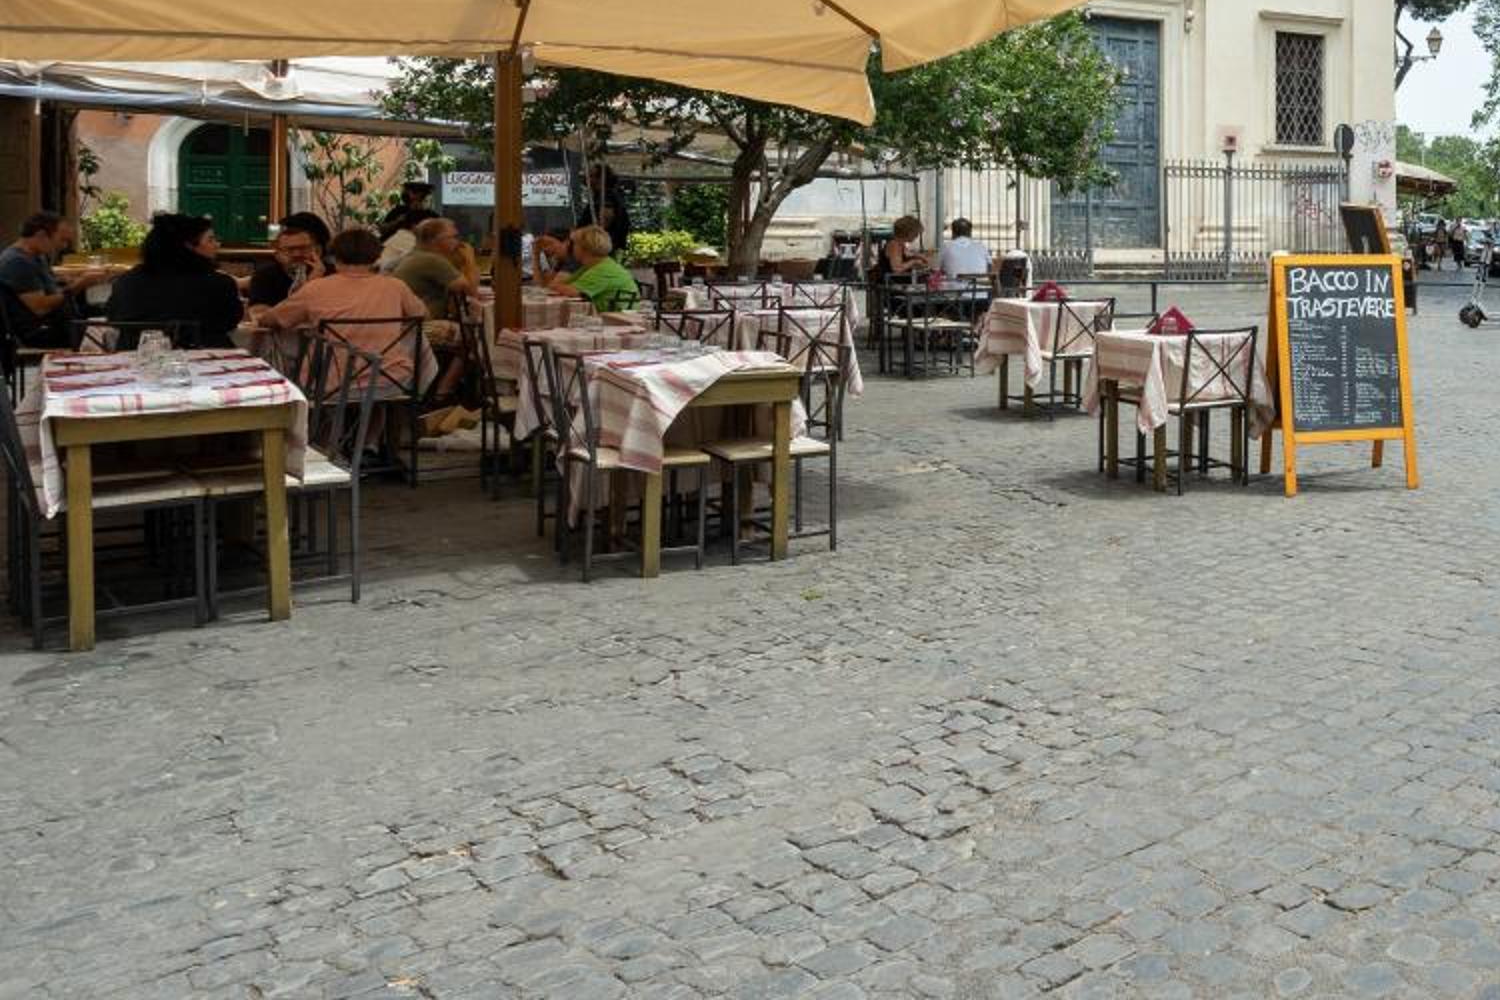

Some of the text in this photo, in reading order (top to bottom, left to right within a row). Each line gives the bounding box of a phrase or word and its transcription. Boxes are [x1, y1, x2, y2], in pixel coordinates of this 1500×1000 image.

[1290, 268, 1389, 294] BACCO IN
[1288, 296, 1396, 319] TRASTEVERE
